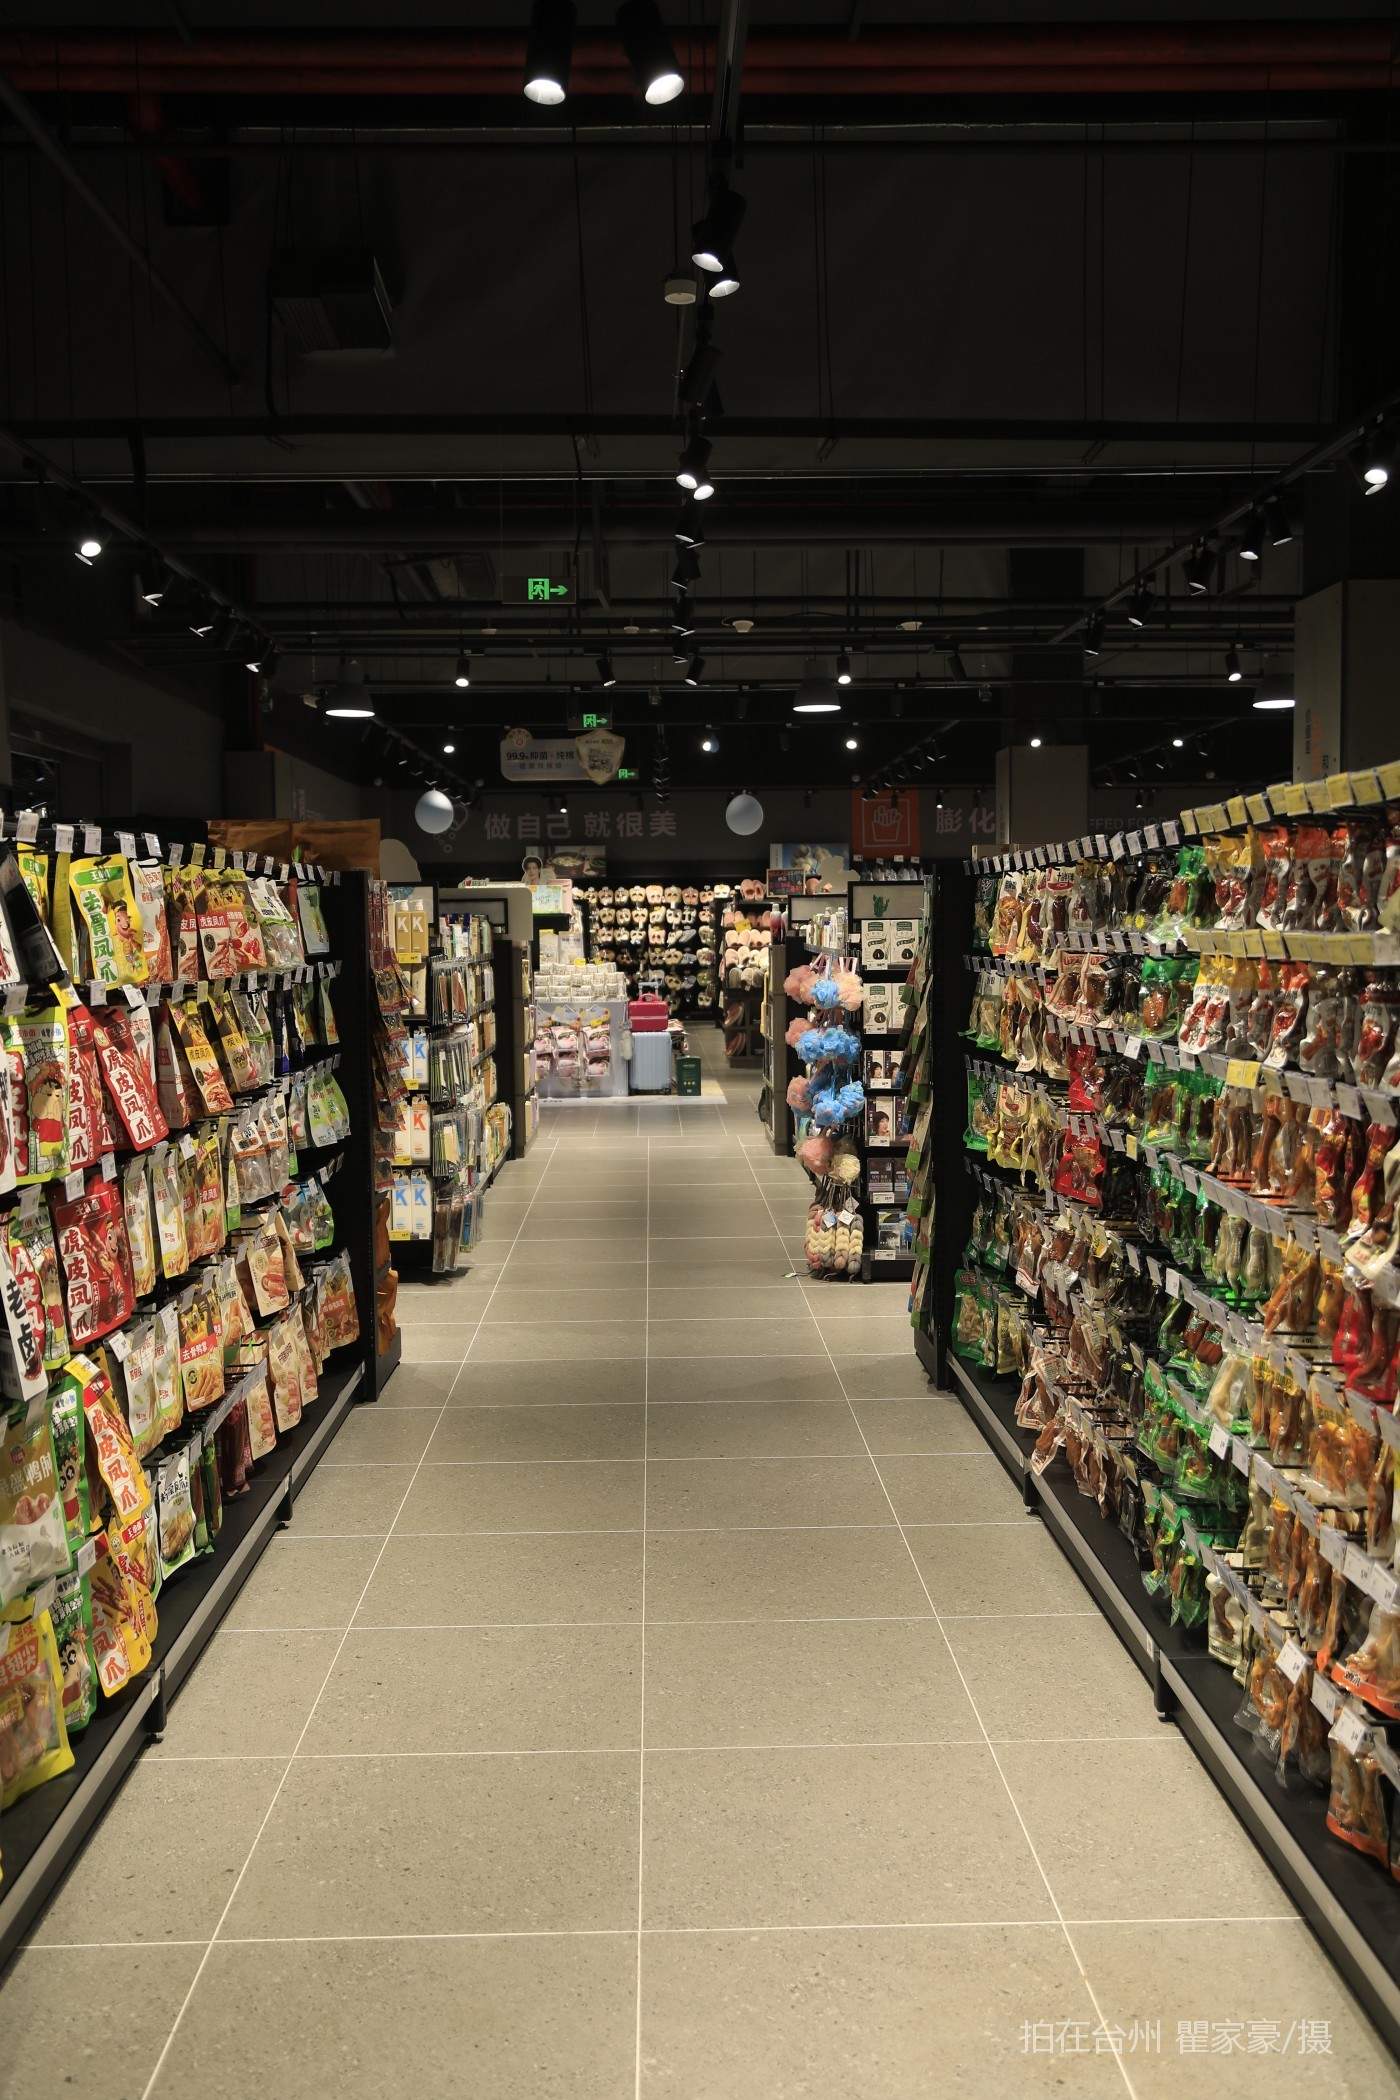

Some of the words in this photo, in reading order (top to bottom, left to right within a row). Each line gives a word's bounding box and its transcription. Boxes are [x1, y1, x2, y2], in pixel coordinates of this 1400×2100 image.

[484, 812, 572, 840] 做自己
[583, 809, 678, 837] 就很美
[935, 807, 996, 834] 膨化
[397, 917, 408, 933] K
[412, 916, 424, 933] K
[82, 890, 118, 984] 去骨凤爪
[415, 1042, 426, 1059] K
[106, 1047, 152, 1141] 虎皮凤爪
[413, 1112, 427, 1131] K
[395, 1188, 408, 1206] K
[415, 1188, 427, 1206] K
[62, 1228, 91, 1338] 虎皮凤爪
[91, 1408, 137, 1513] 虎皮凤爪
